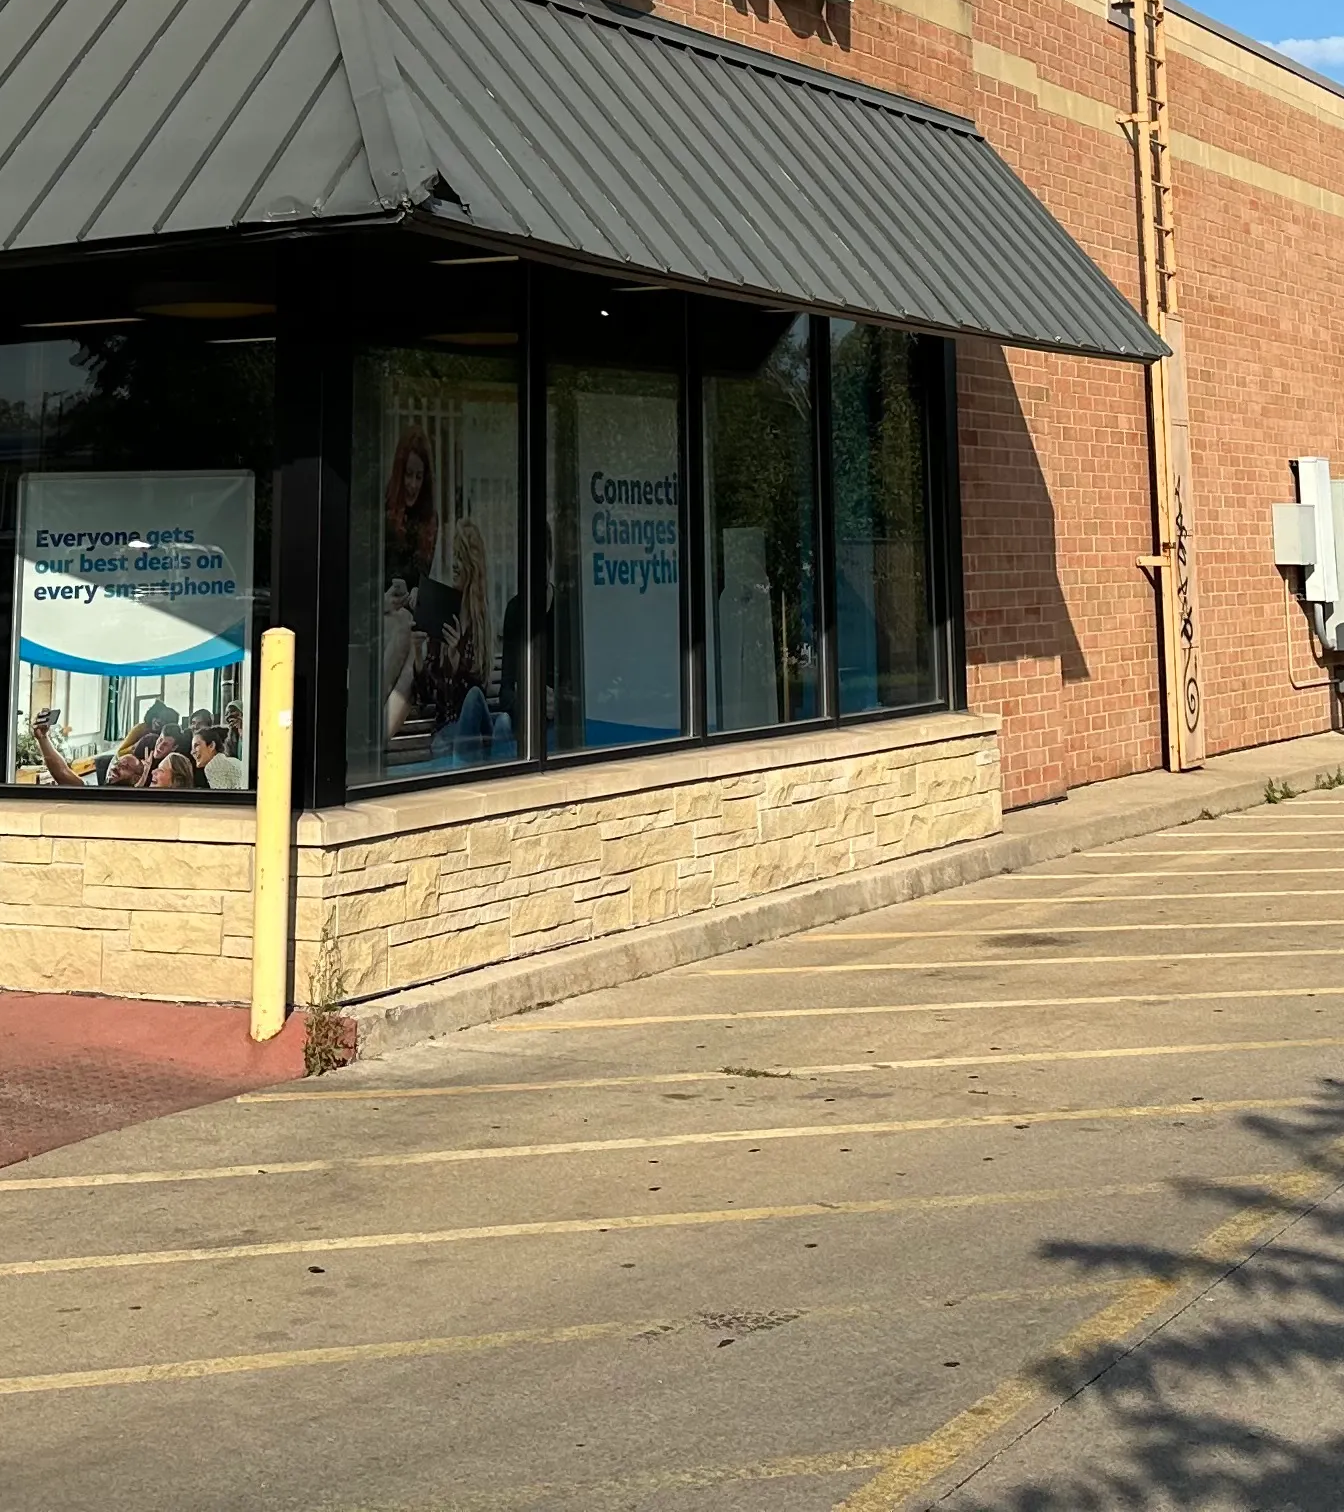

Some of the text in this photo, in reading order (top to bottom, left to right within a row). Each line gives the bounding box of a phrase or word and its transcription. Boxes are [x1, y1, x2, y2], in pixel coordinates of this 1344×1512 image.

[35, 527, 195, 552] Everyone gets
[592, 509, 677, 554] Changes
[35, 551, 223, 575] our best deals on
[34, 584, 99, 605] every
